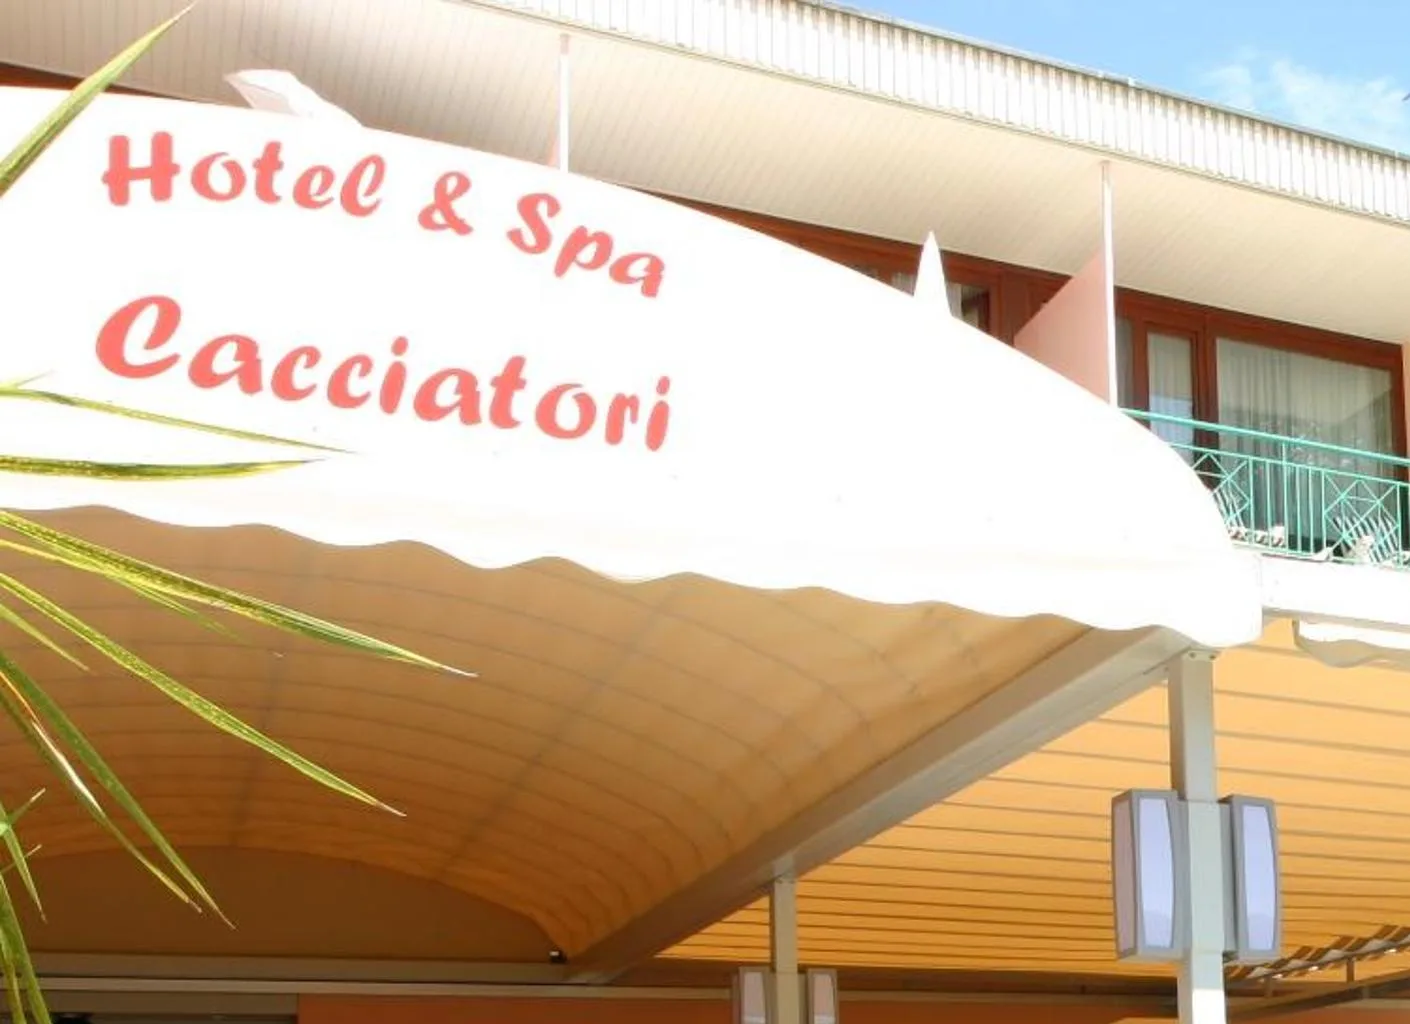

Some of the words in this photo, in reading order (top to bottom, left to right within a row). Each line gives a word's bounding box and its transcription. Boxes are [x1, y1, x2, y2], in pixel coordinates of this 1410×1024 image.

[102, 131, 387, 218] Hotel
[418, 173, 473, 237] &
[506, 192, 667, 299] Spa
[95, 294, 672, 453] Cacciatori
